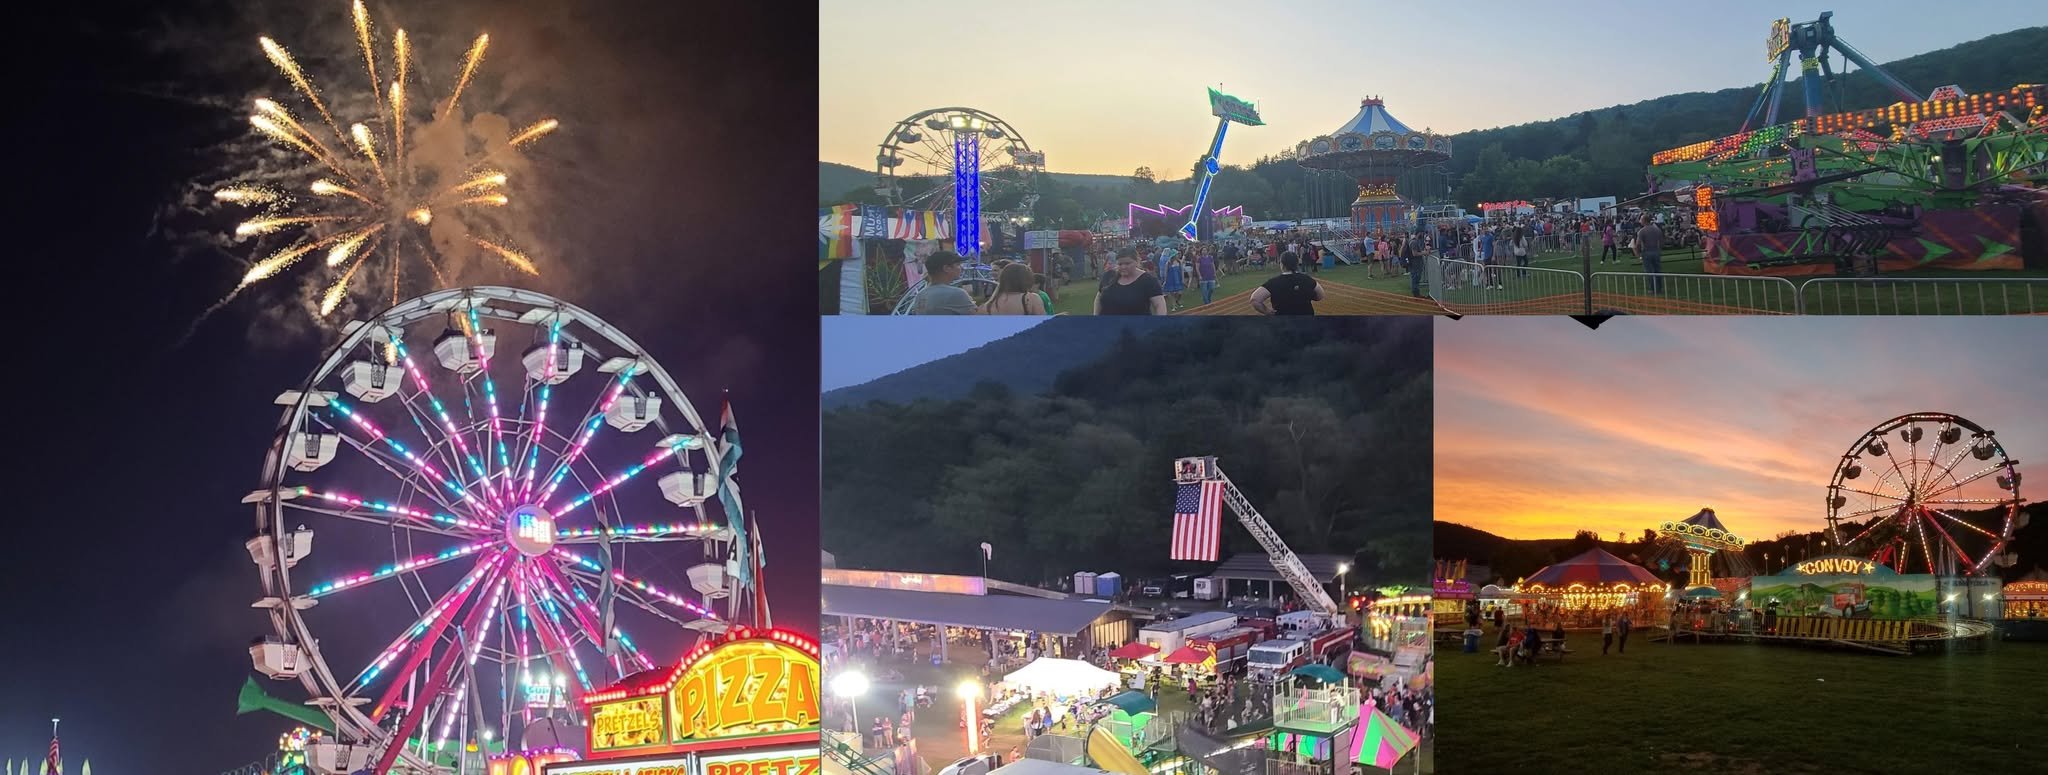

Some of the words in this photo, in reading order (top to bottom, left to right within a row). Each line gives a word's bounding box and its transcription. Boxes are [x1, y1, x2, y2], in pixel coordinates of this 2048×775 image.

[1804, 558, 1862, 575] CONVOY
[679, 655, 819, 739] PIZZA
[596, 710, 660, 736] PRETZELS
